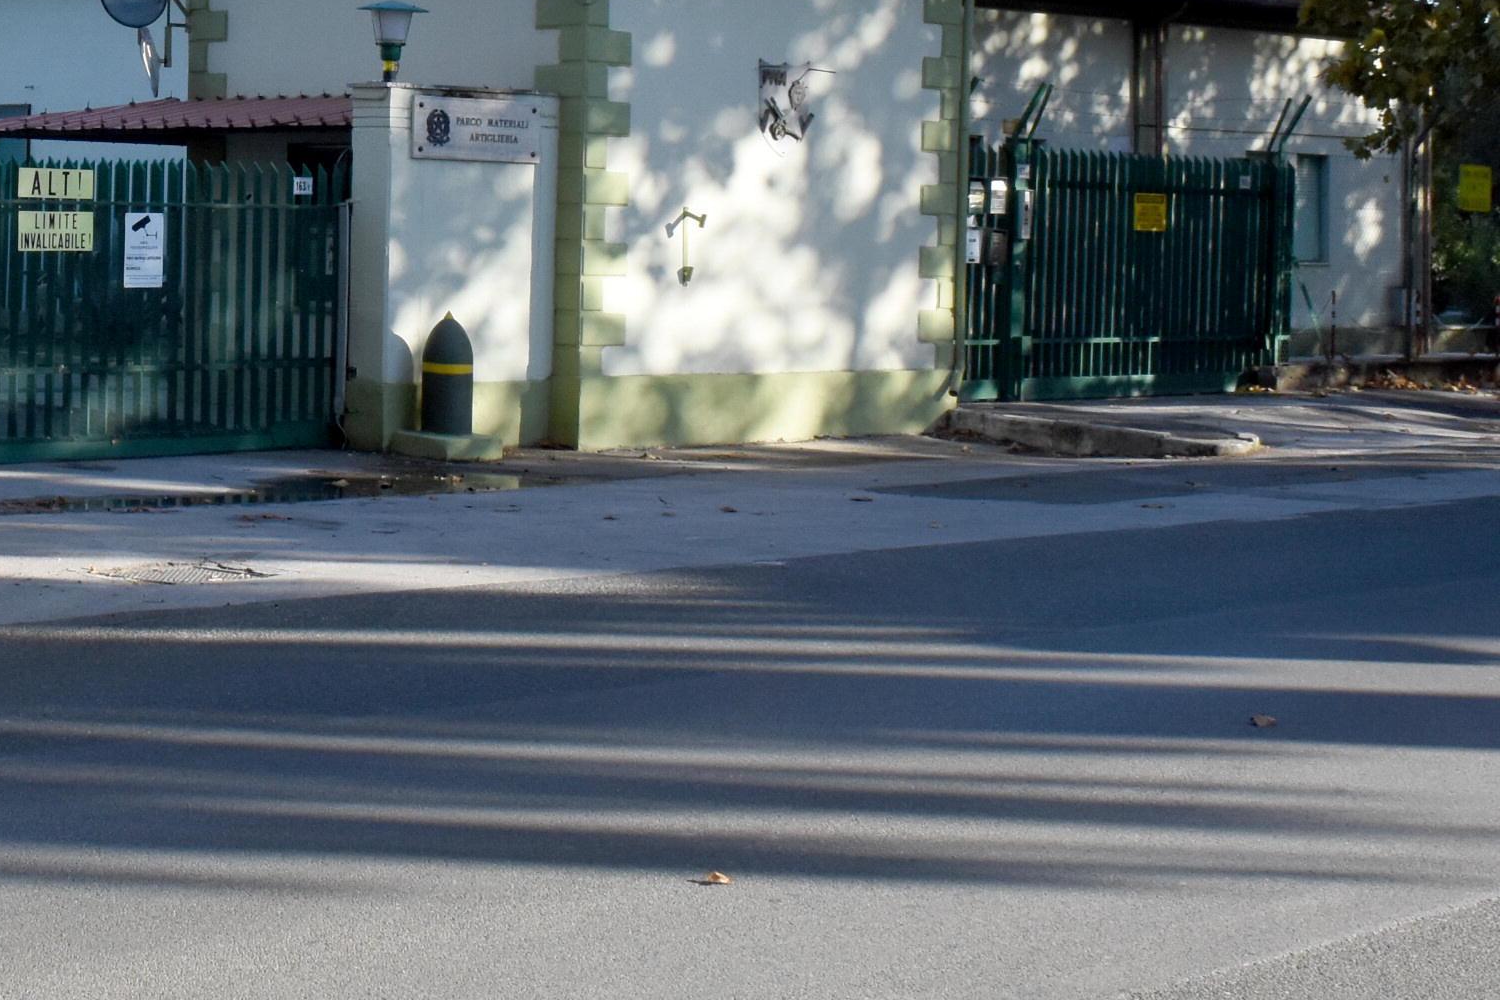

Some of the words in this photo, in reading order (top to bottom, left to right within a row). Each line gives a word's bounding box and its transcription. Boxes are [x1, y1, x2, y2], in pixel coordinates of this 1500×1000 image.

[456, 116, 483, 127] PARCO
[488, 118, 530, 129] MATERIALI
[469, 133, 519, 144] ARTIGLIERIA
[35, 213, 78, 230] LIMITE
